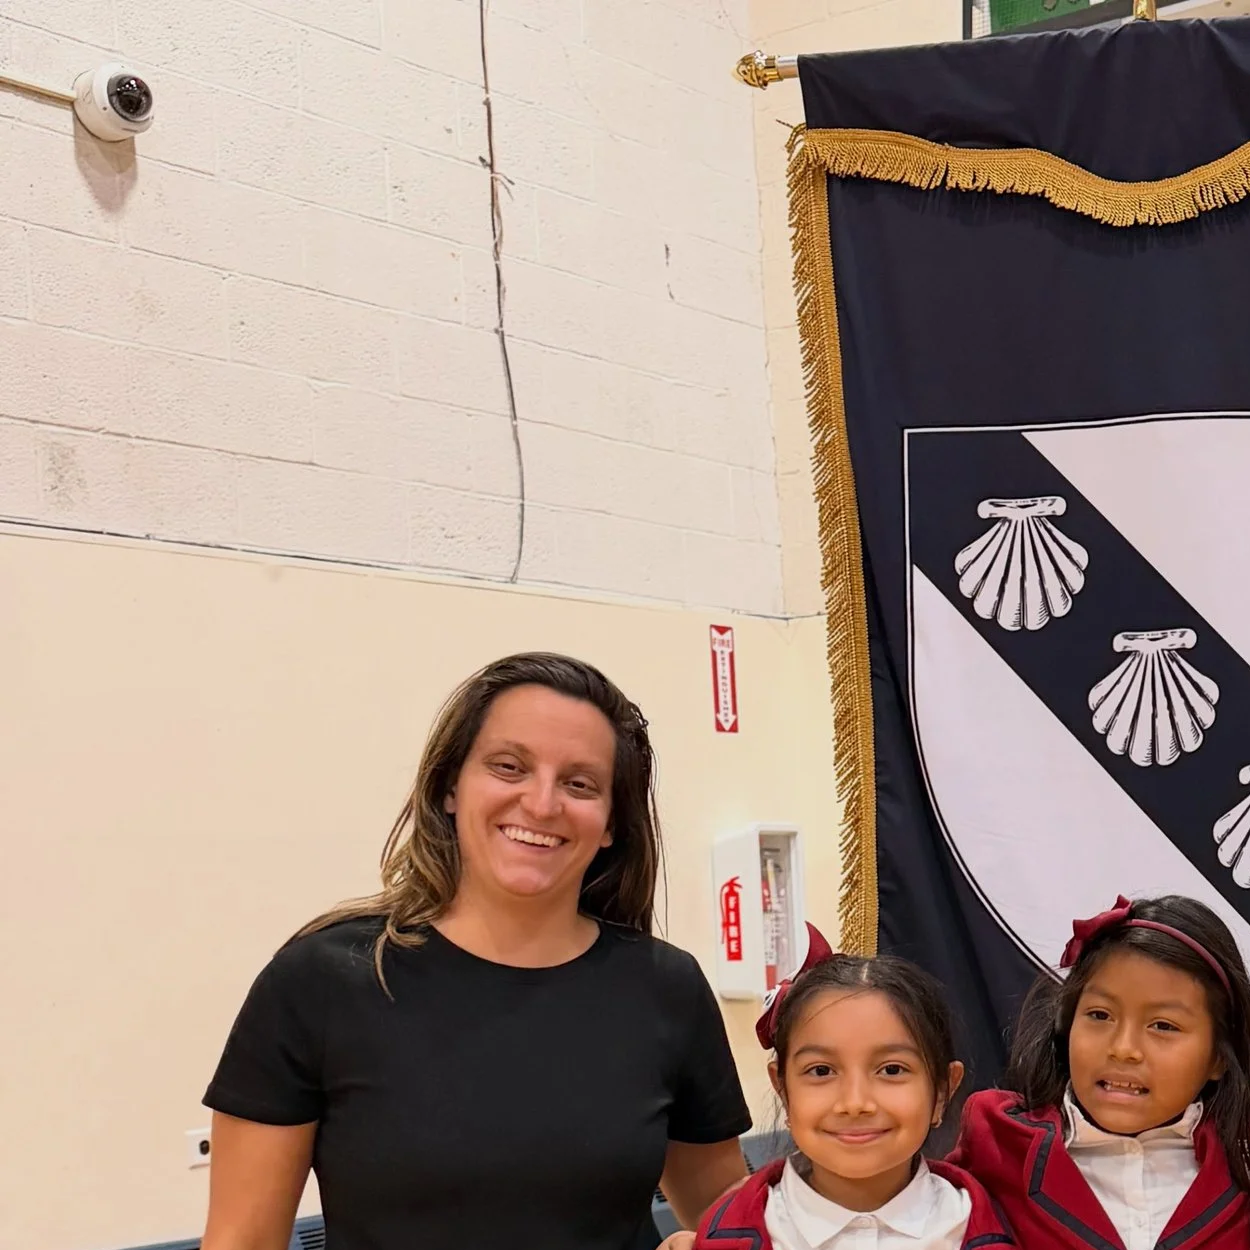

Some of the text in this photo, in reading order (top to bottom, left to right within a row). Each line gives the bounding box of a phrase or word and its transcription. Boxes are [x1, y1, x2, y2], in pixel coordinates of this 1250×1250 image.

[712, 637, 730, 648] FIRE
[720, 650, 729, 723] EXTINGUISHER
[729, 897, 739, 952] FIRE
